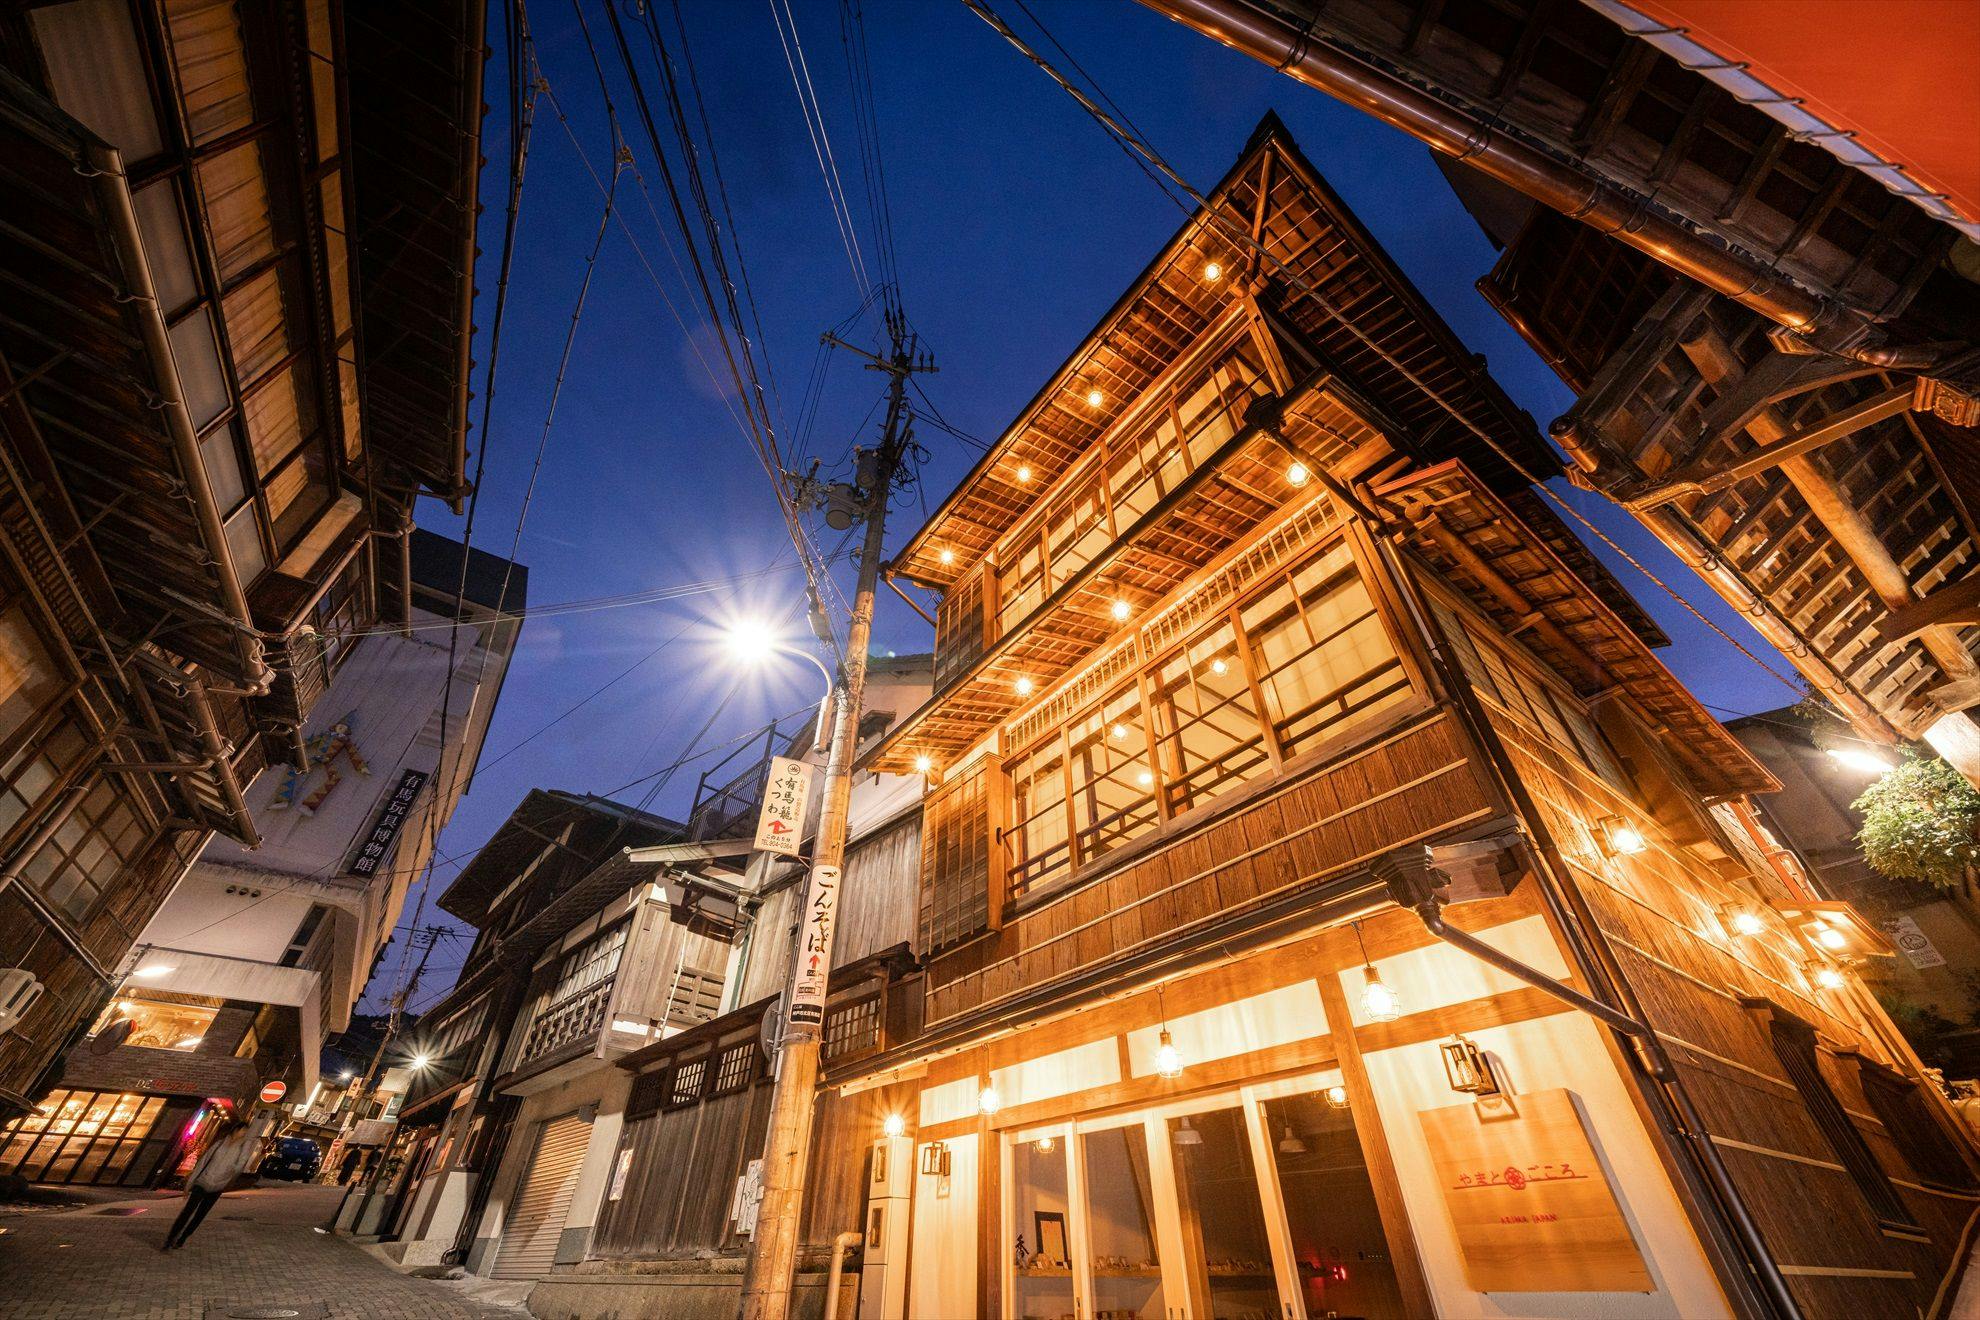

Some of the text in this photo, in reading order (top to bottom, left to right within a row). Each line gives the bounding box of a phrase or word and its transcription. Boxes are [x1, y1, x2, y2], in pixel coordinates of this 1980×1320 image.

[767, 778, 783, 814] くつわ
[779, 777, 798, 821] 有馬籠
[354, 775, 422, 873] 有馬玩具博物館
[807, 871, 834, 954] ごんそば
[1499, 1213, 1559, 1225] ARIMA JAPAN
